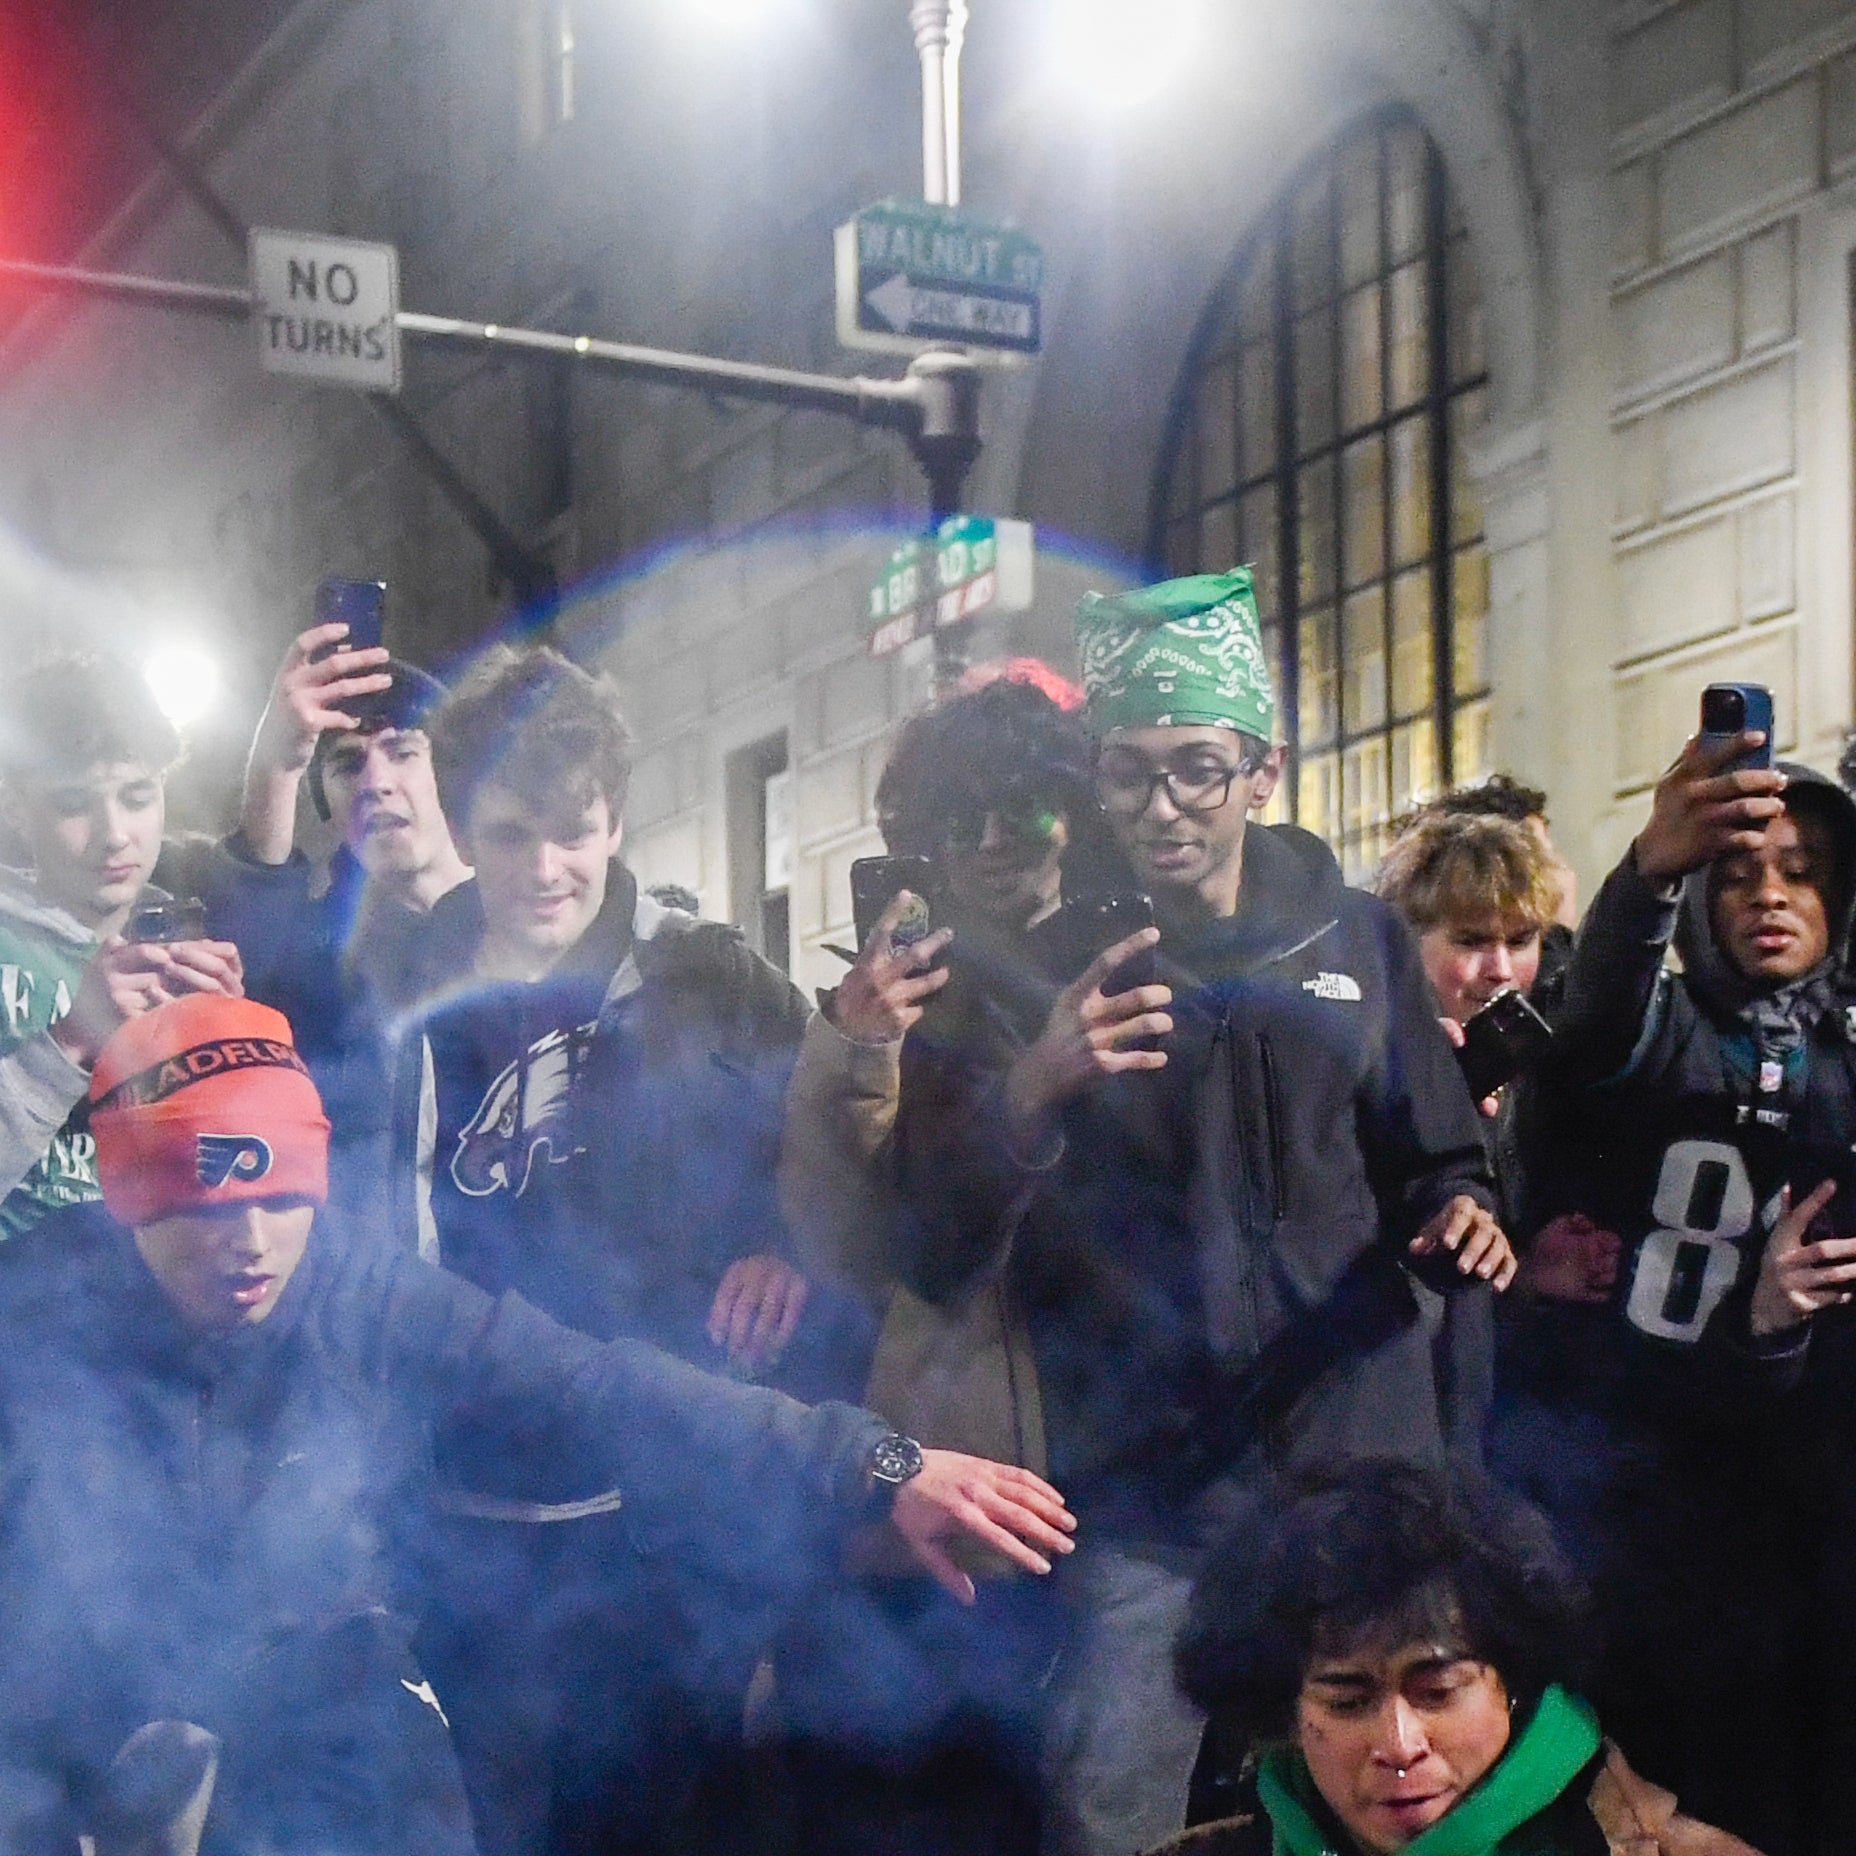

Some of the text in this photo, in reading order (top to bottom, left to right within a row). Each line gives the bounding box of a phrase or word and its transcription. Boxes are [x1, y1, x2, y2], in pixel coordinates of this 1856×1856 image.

[859, 222, 1001, 278] WALNUT
[287, 259, 359, 306] NO
[267, 314, 386, 361] TURNS
[1626, 1139, 1785, 1342] 8
